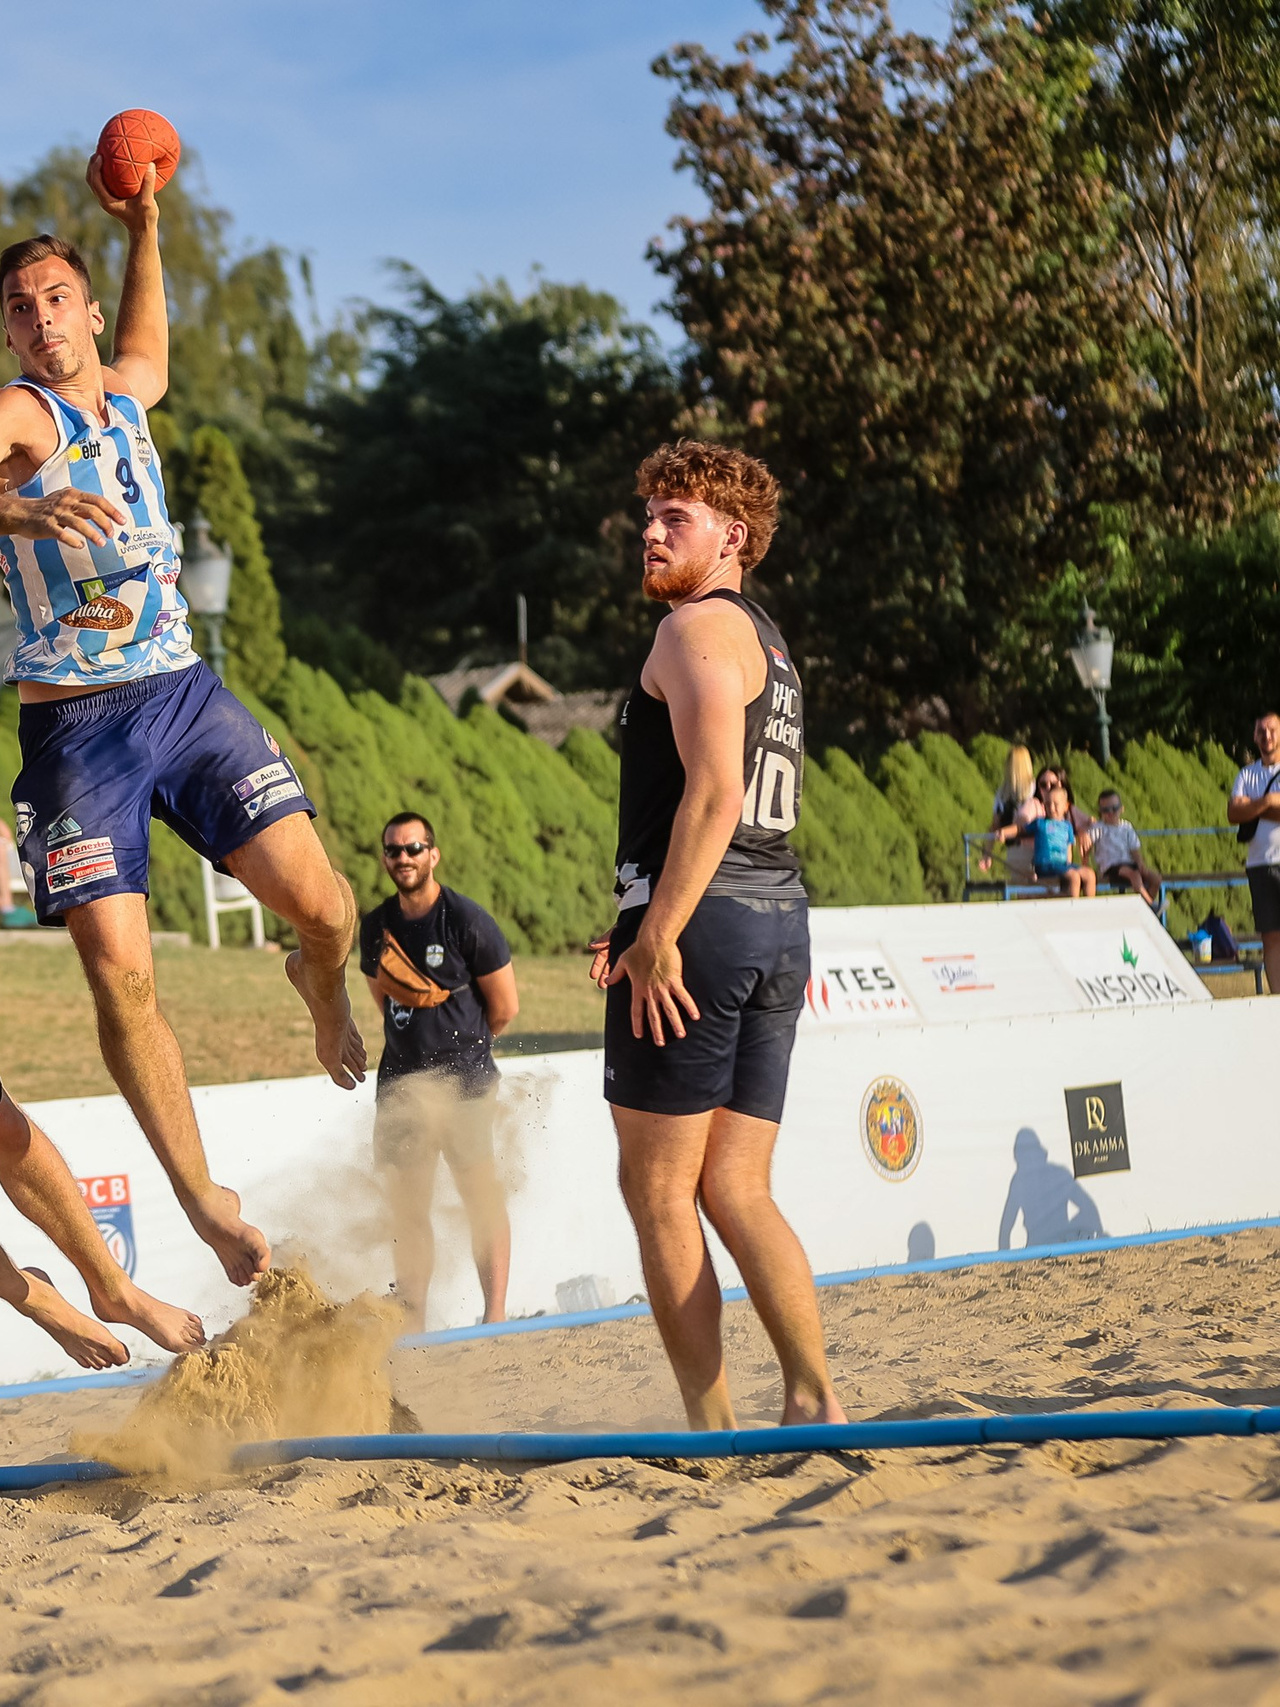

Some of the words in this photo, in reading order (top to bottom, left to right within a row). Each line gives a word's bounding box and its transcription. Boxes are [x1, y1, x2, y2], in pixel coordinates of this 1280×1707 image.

[81, 440, 101, 460] ebt
[115, 457, 140, 504] 9
[741, 746, 796, 833] 10
[66, 840, 111, 856] benextra
[827, 966, 896, 993] TES
[1075, 970, 1188, 1006] INSPIRA
[1074, 1135, 1125, 1158] DRAMMA
